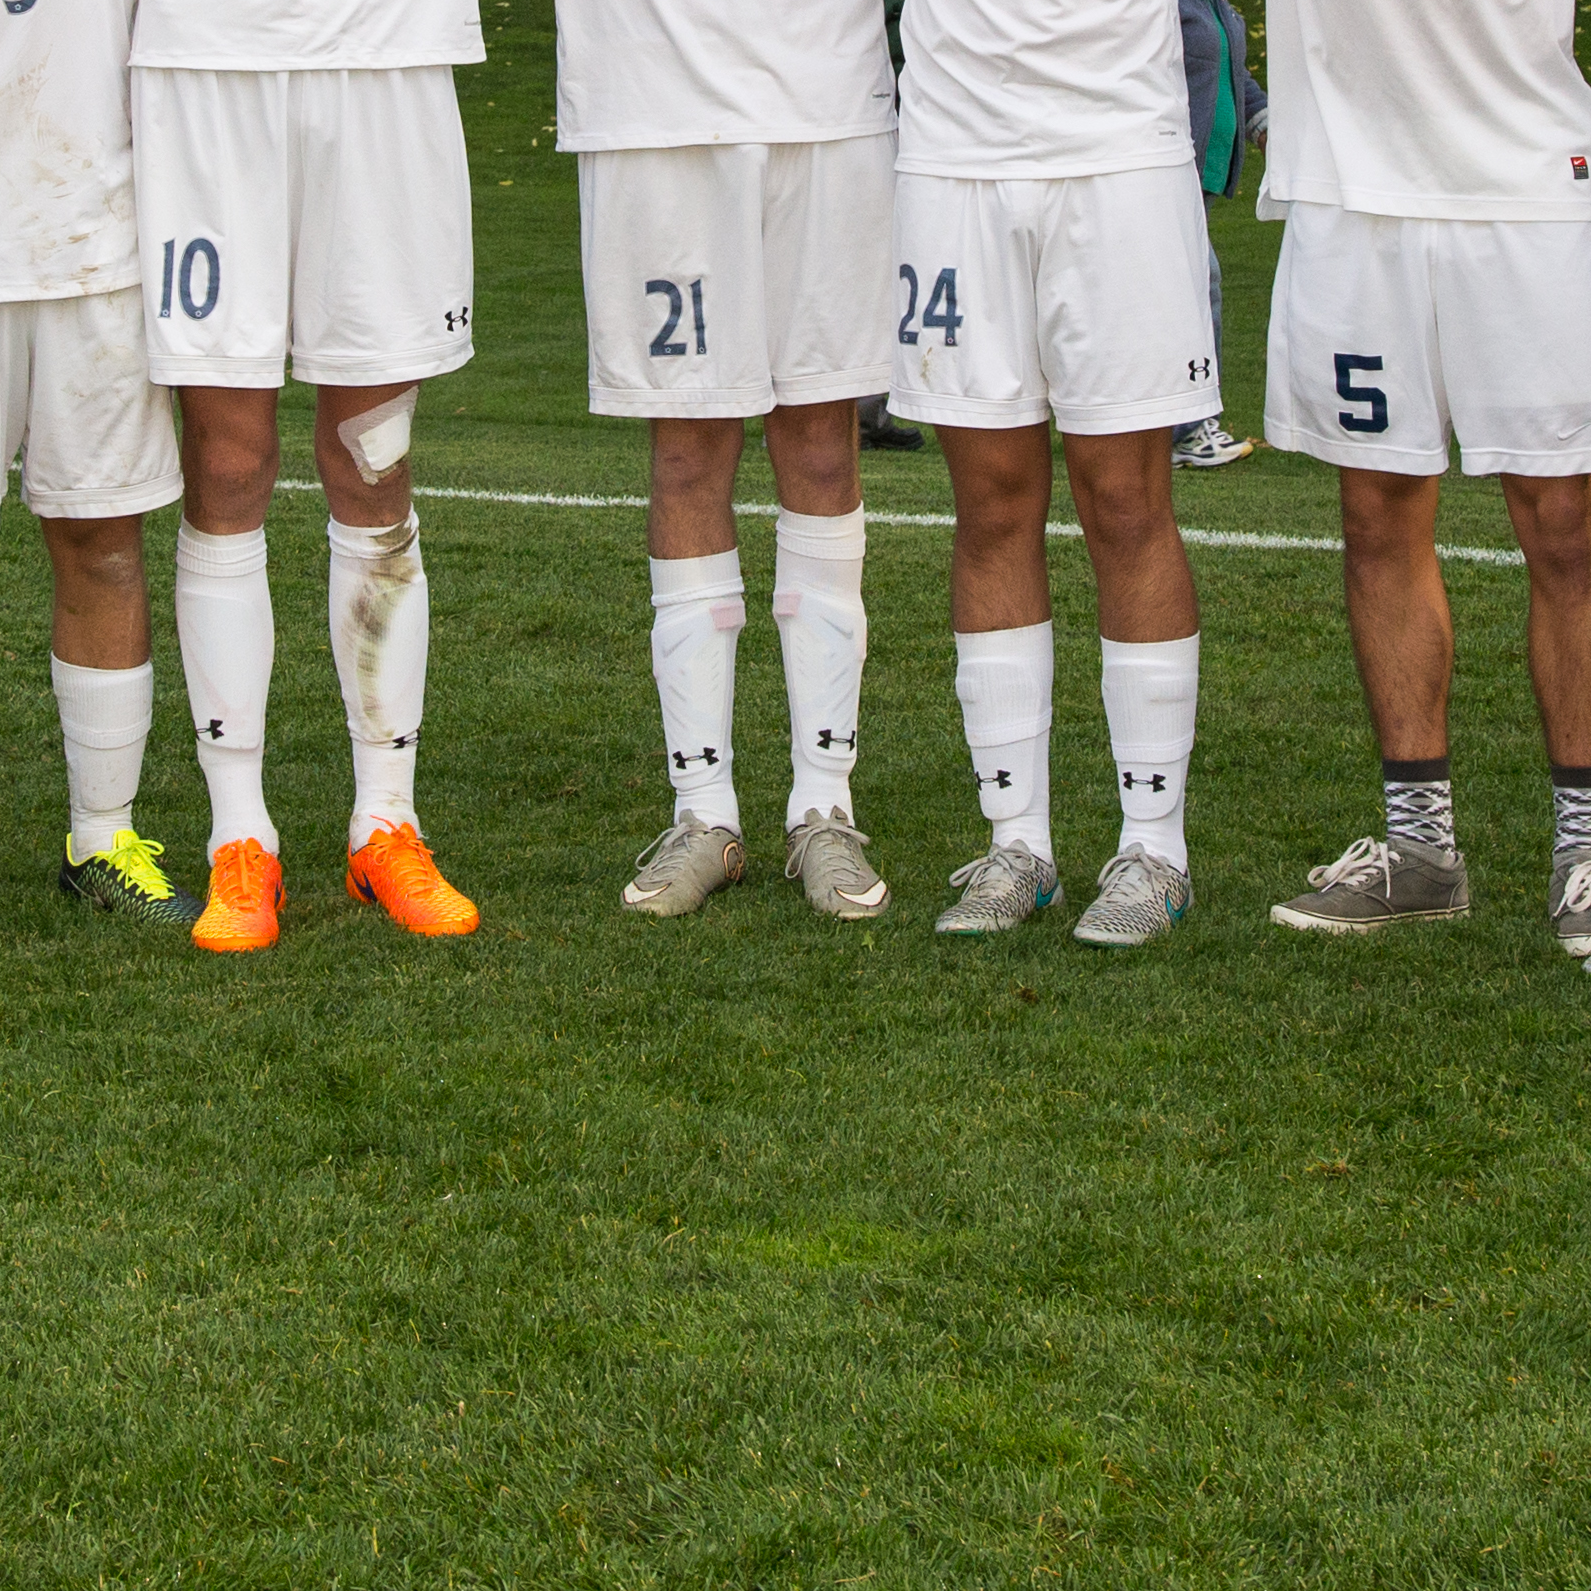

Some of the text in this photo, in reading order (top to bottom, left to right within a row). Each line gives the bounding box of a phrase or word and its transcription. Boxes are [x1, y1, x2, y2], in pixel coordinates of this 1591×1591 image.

[162, 239, 219, 319] 10
[647, 279, 706, 356] 21
[899, 264, 962, 346] 24
[1334, 354, 1388, 433] 5
